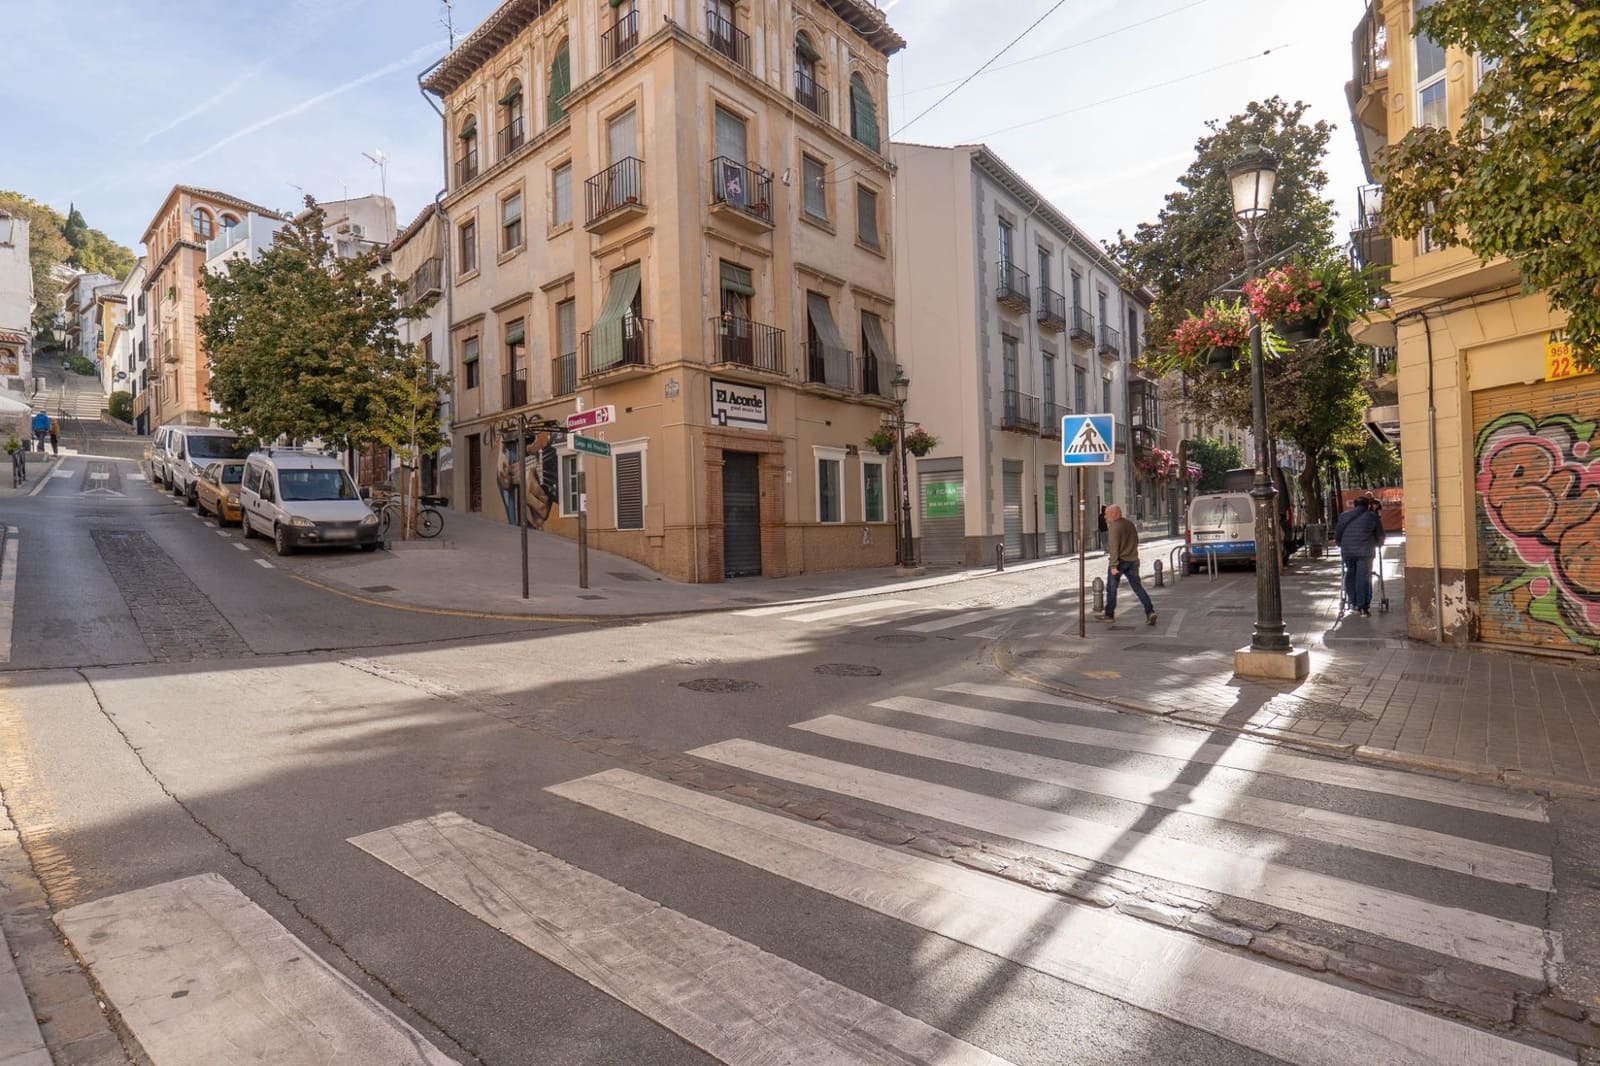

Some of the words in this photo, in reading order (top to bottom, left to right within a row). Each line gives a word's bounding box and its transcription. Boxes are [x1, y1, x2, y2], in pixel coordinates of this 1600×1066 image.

[1551, 346, 1569, 357] 958
[715, 389, 728, 403] El
[728, 391, 763, 408] Acorde
